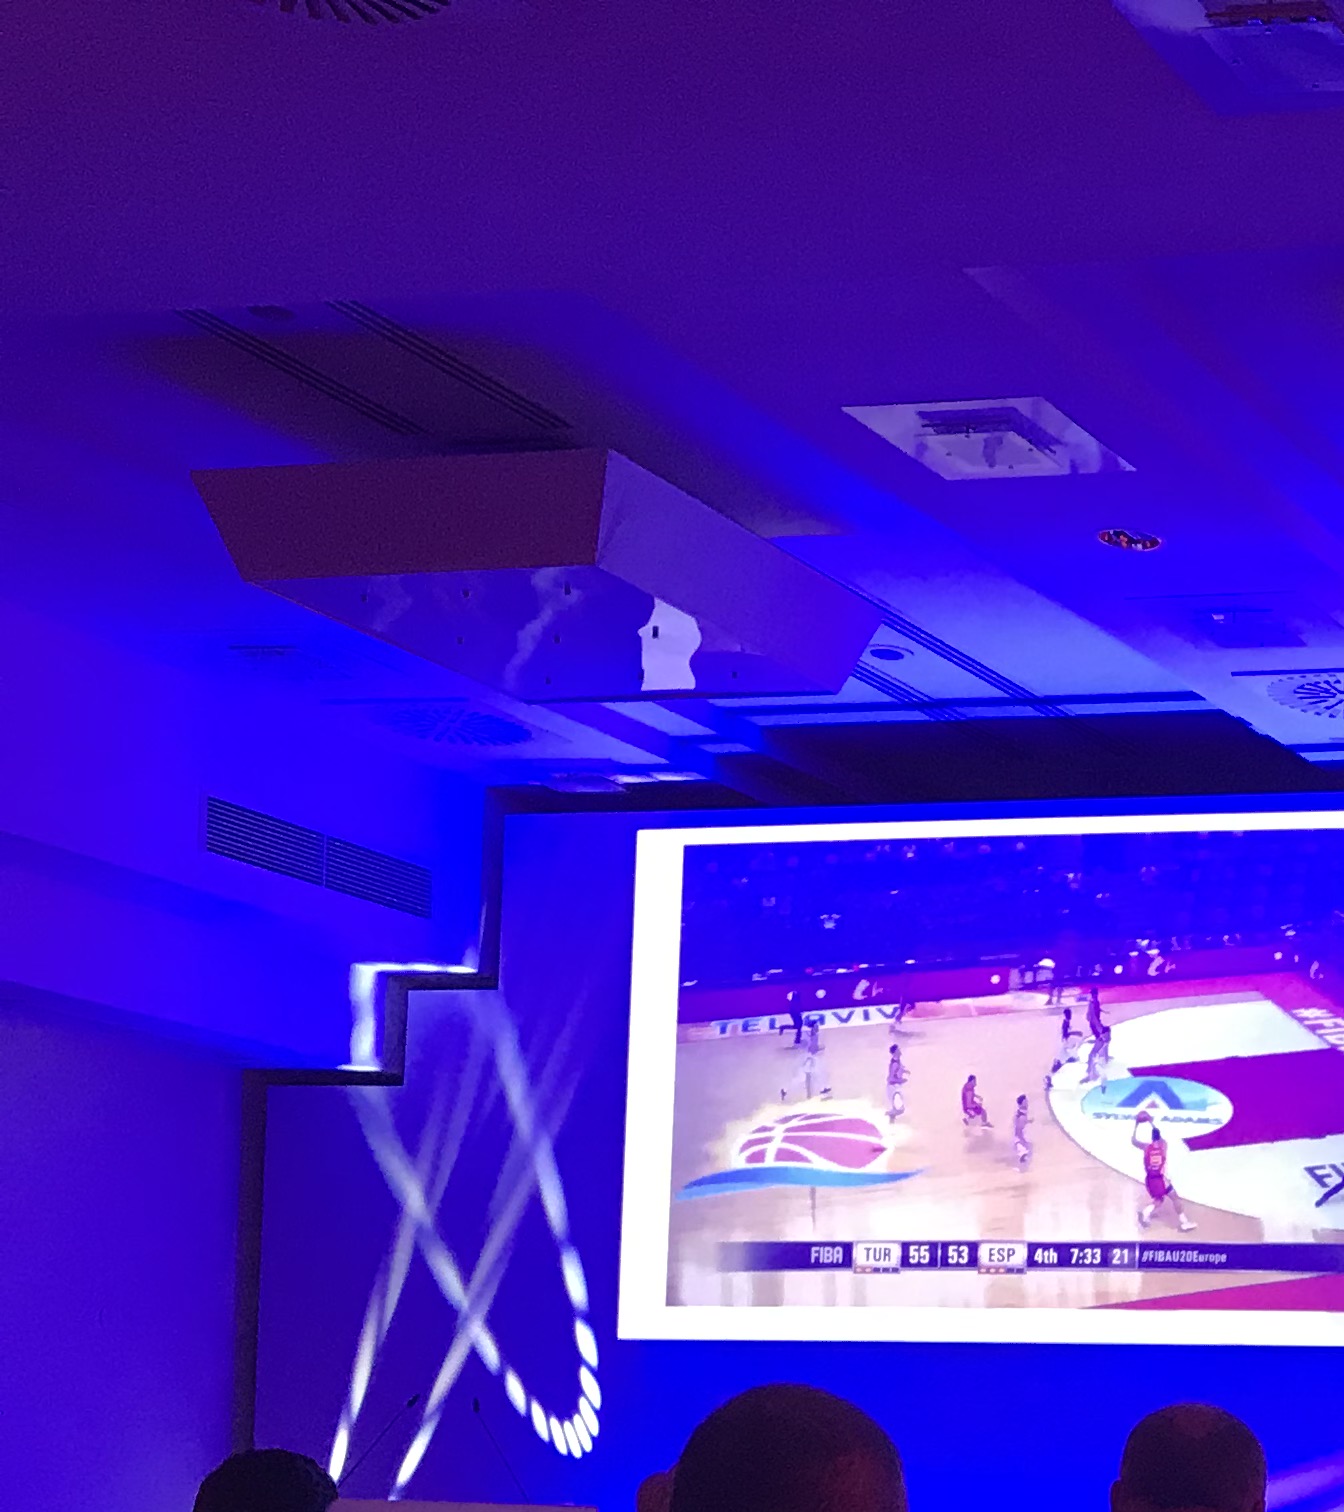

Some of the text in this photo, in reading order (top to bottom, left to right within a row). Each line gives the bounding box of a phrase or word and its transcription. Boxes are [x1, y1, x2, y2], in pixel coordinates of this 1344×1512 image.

[810, 1245, 1228, 1265] FIBA TUR 55 53 ESP 4th 7:33 21 #FIBAU20Europe
